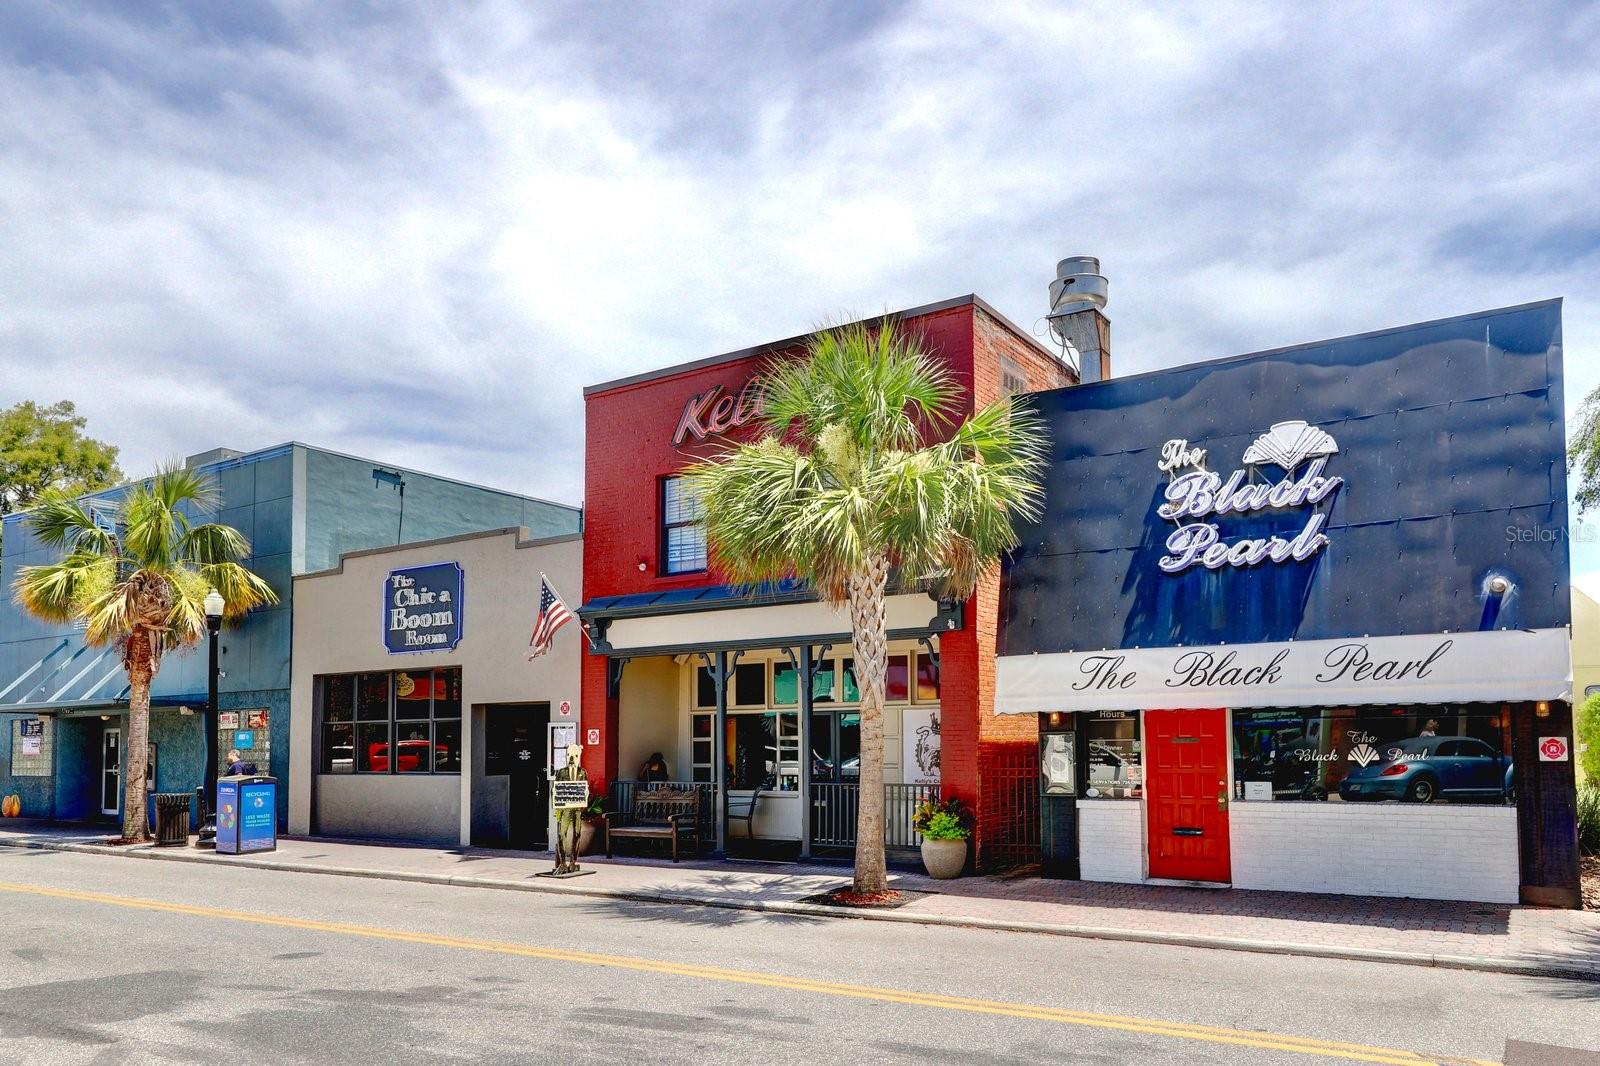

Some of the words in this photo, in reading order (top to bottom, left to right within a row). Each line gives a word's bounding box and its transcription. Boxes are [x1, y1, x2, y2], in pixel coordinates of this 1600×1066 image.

[1157, 439, 1207, 471] The
[1156, 458, 1344, 520] Black
[1157, 512, 1330, 573] Pearl
[391, 574, 415, 588] The
[394, 586, 437, 607] Chic
[438, 590, 452, 603] a
[389, 607, 454, 630] Boom
[404, 630, 448, 646] Room
[1071, 655, 1137, 691] The
[1164, 648, 1290, 688] Black
[1315, 639, 1454, 683] Pearl
[1099, 710, 1126, 718] Hours
[1346, 730, 1378, 744] The
[1294, 748, 1340, 762] Black
[1387, 747, 1431, 762] Pearl
